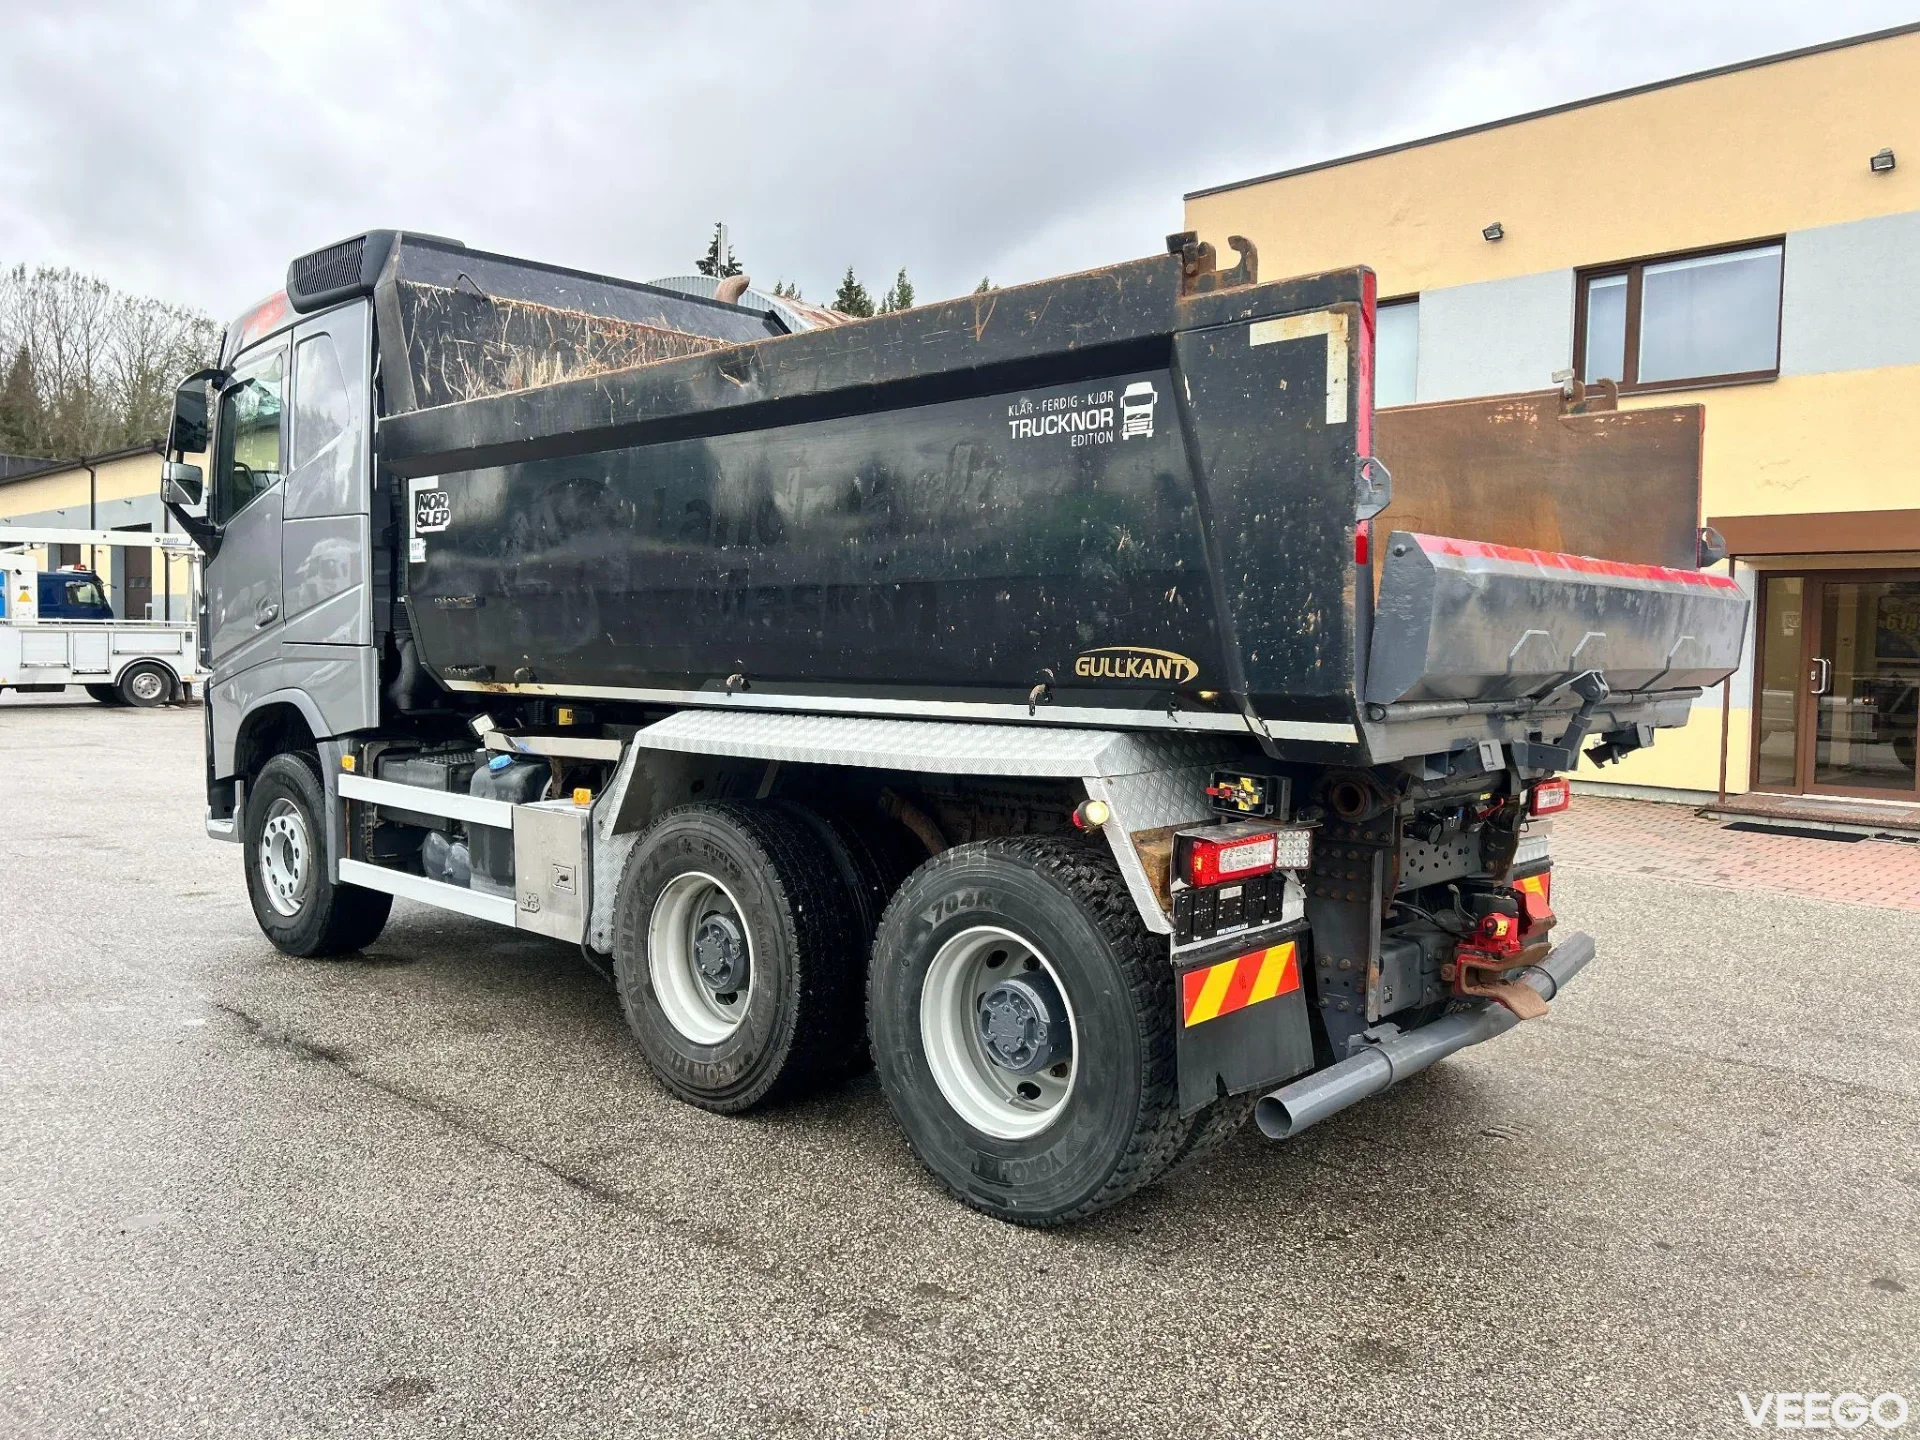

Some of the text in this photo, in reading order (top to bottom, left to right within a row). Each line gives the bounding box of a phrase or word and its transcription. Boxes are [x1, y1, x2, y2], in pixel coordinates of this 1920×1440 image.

[1008, 402, 1033, 417] KLAR
[1042, 395, 1078, 412] FERDIG
[1087, 390, 1114, 405] KJØR
[1008, 407, 1114, 439] TRUCKNOR
[1071, 430, 1114, 447] EDITION
[418, 491, 448, 510] NOR
[416, 508, 451, 529] SLEP
[1074, 656, 1188, 680] GULLKANT
